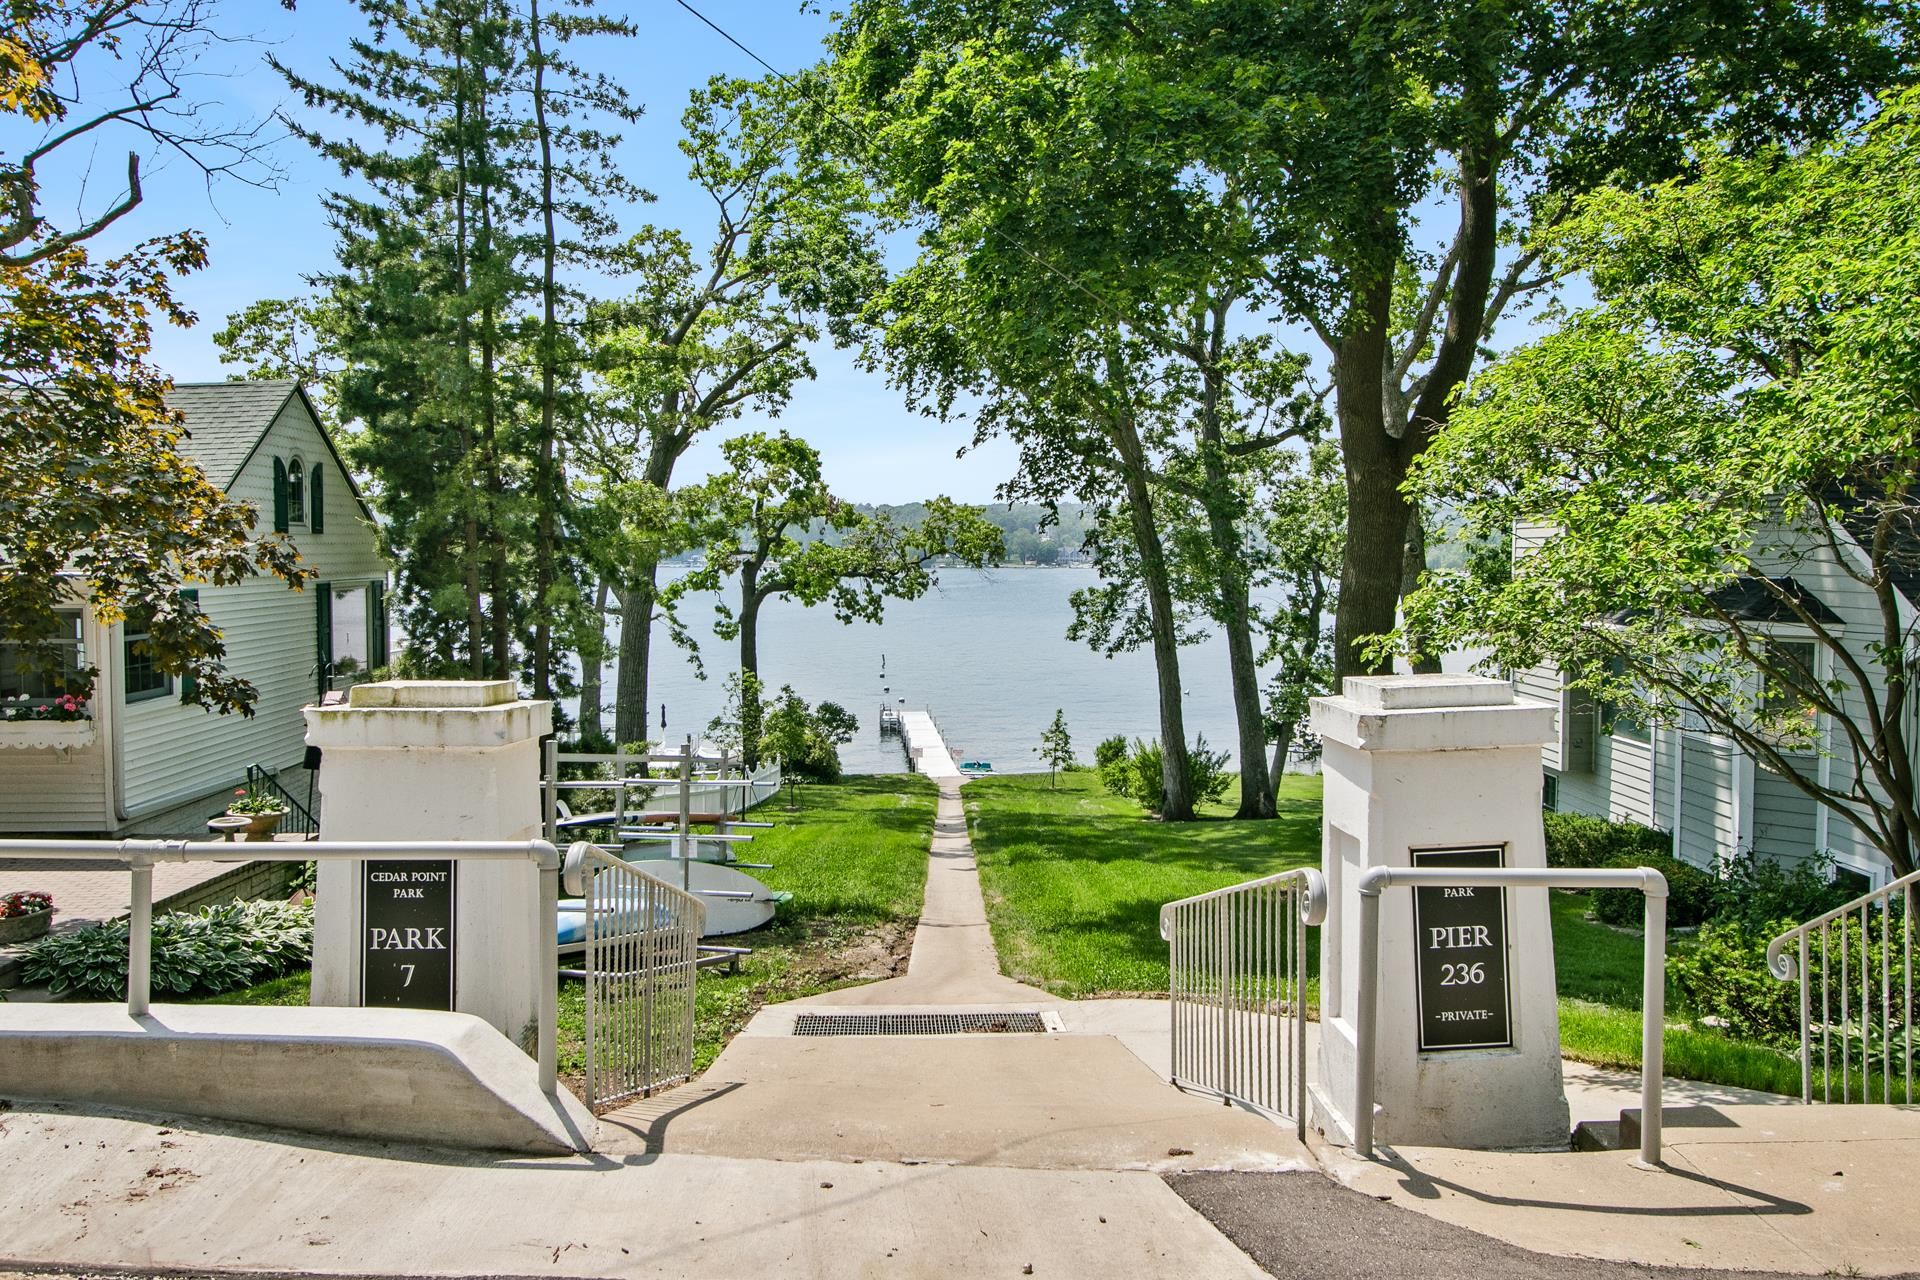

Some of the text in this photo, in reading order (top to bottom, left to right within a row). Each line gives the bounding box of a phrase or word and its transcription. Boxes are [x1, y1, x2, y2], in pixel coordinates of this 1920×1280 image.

[370, 872, 447, 882] CEDAR POINT
[393, 888, 424, 898] PARK
[1444, 887, 1475, 898] PARK
[369, 927, 447, 950] PARK
[1429, 925, 1493, 949] PIER
[400, 964, 415, 987] 7
[1440, 962, 1485, 986] 236
